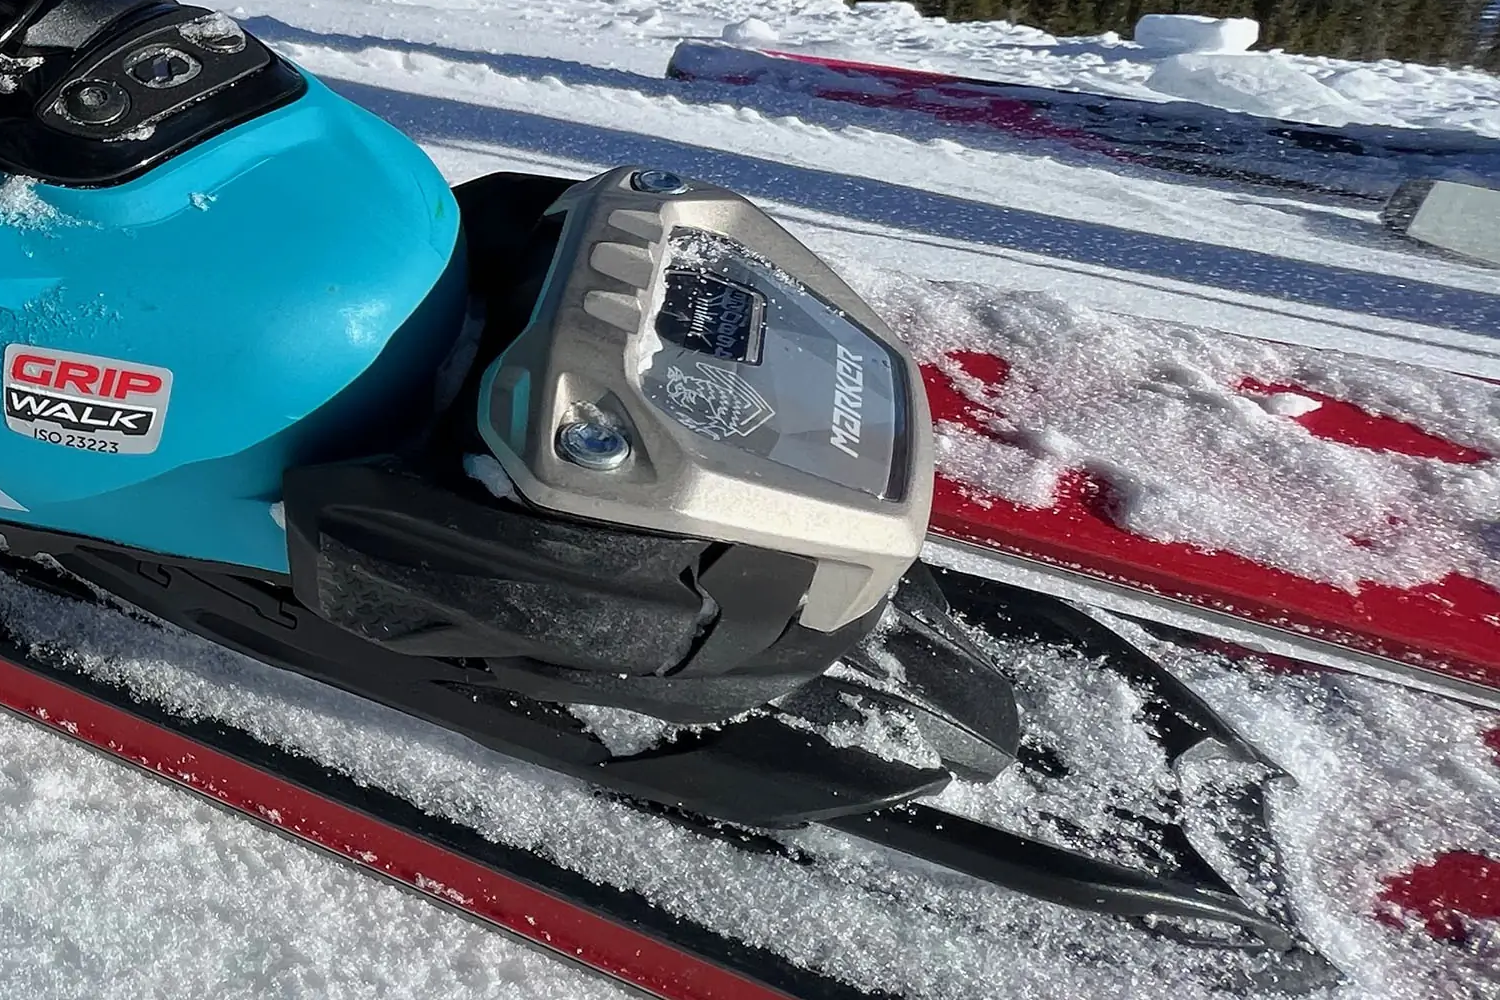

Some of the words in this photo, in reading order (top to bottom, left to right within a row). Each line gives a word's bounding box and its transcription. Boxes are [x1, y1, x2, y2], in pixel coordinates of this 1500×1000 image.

[12, 354, 162, 399] GRIP
[10, 391, 147, 429] WALK
[830, 343, 863, 458] MARKER
[34, 427, 62, 444] ISO
[66, 434, 119, 453] 23223
